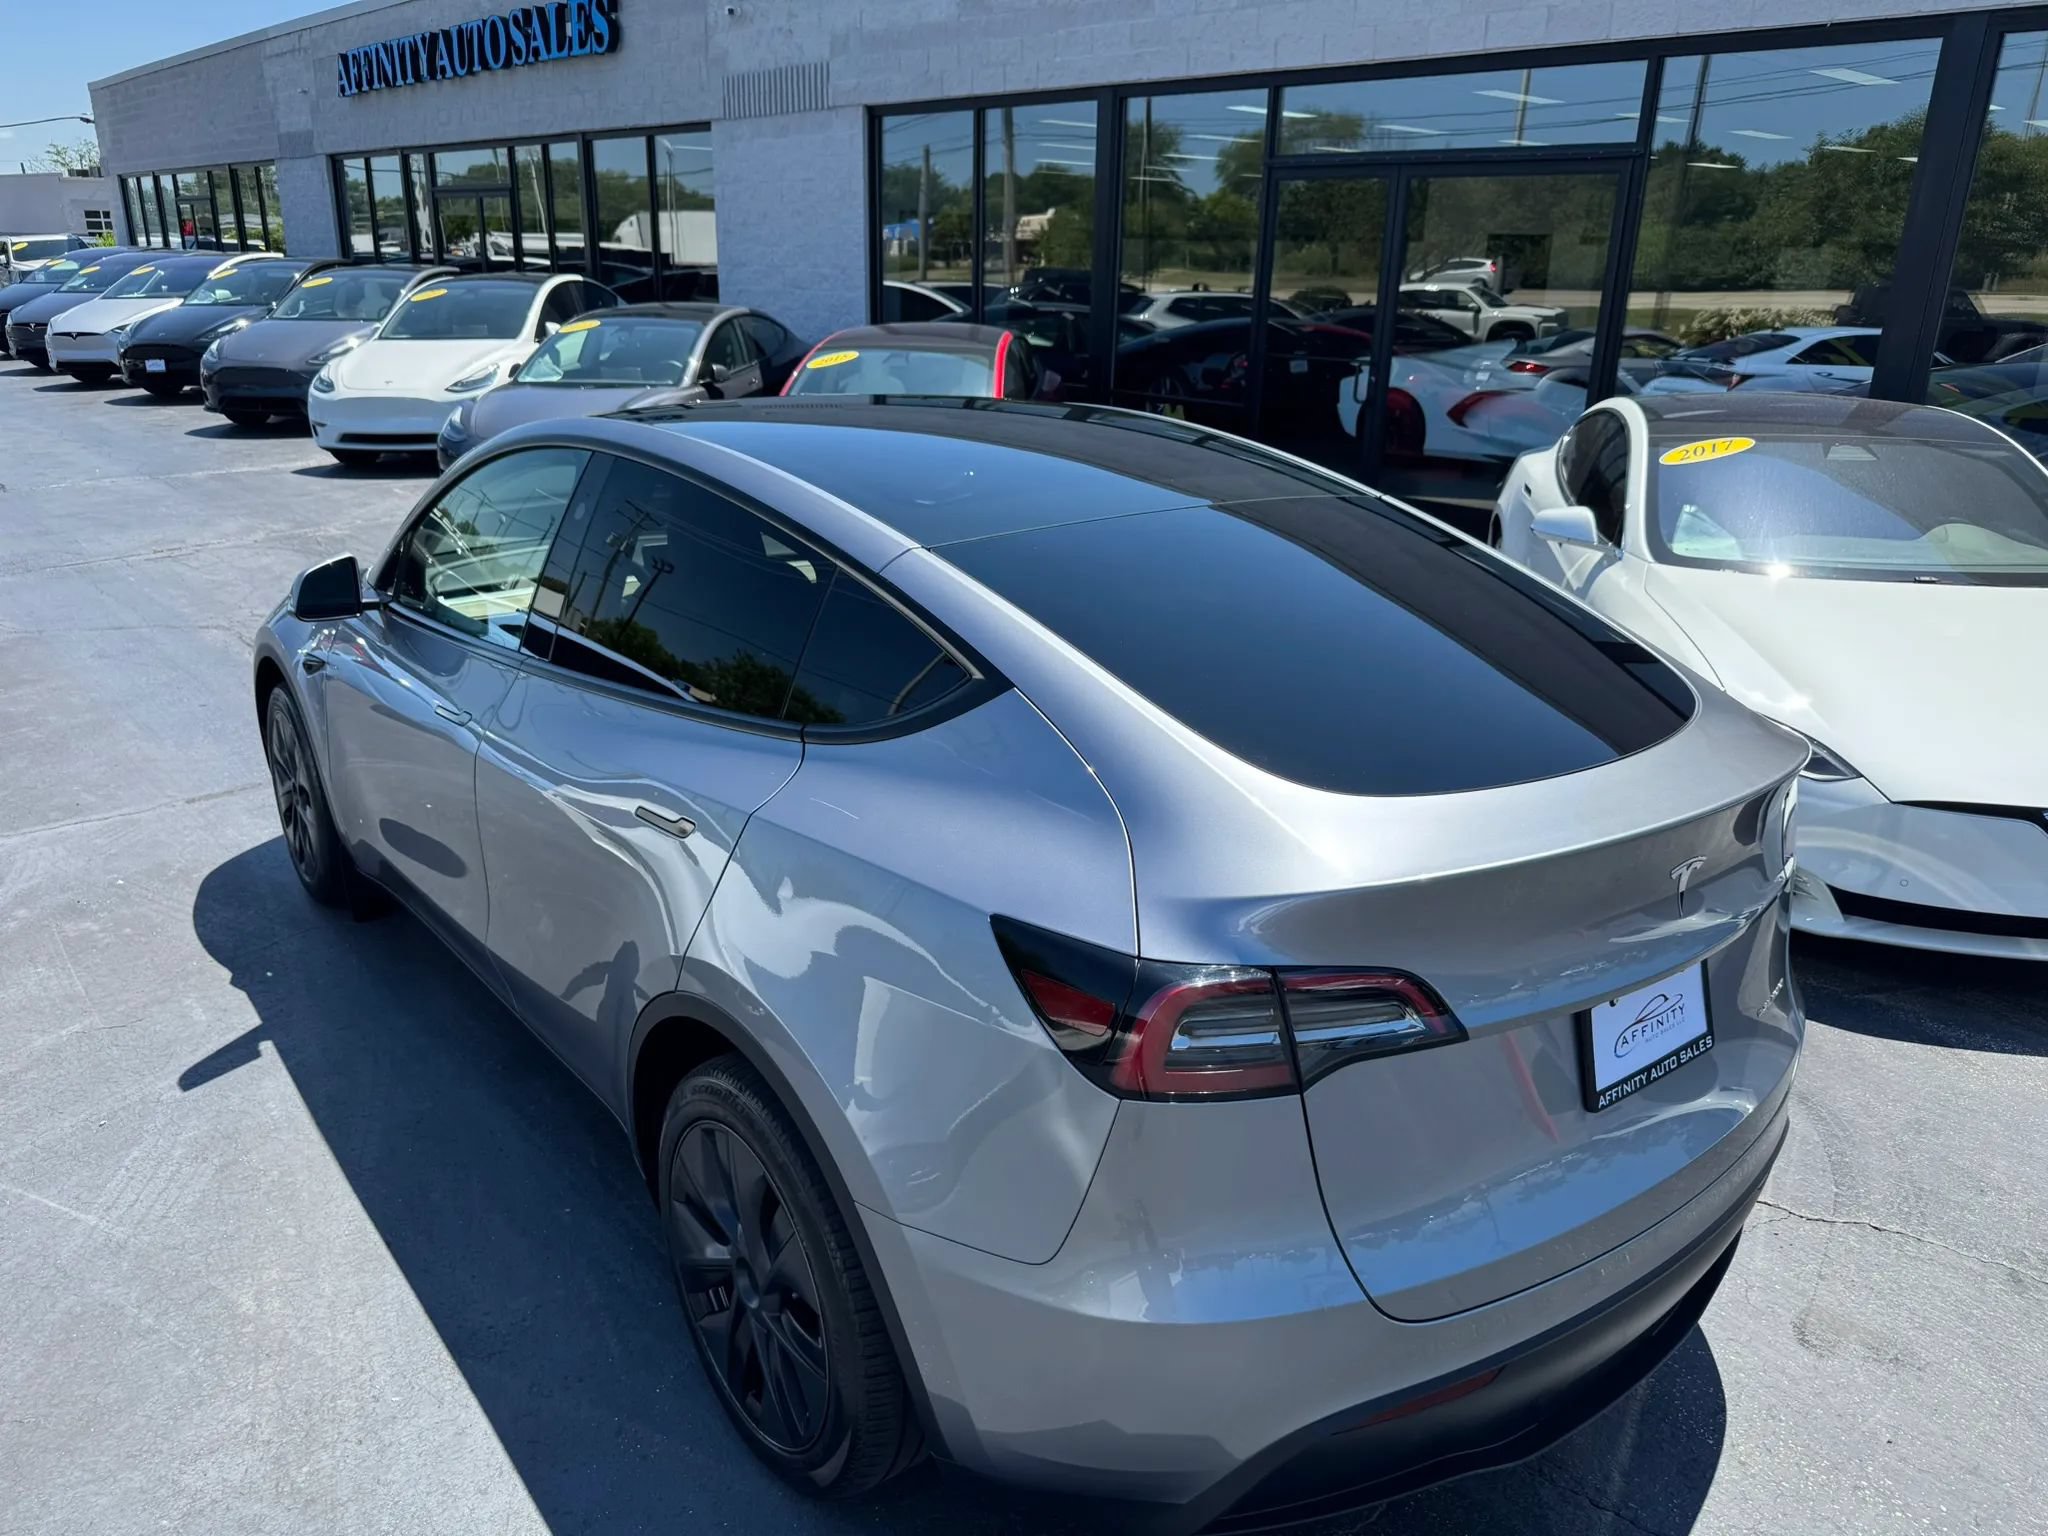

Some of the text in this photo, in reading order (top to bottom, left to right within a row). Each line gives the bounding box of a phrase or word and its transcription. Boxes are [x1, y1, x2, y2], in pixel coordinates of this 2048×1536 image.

[337, 0, 614, 97] AFFINITY AUTO SALES
[1678, 439, 1734, 462] 2017
[1620, 1002, 1686, 1049] AFFINITY
[1598, 1035, 1713, 1109] AFFINITY AUTO SALES
